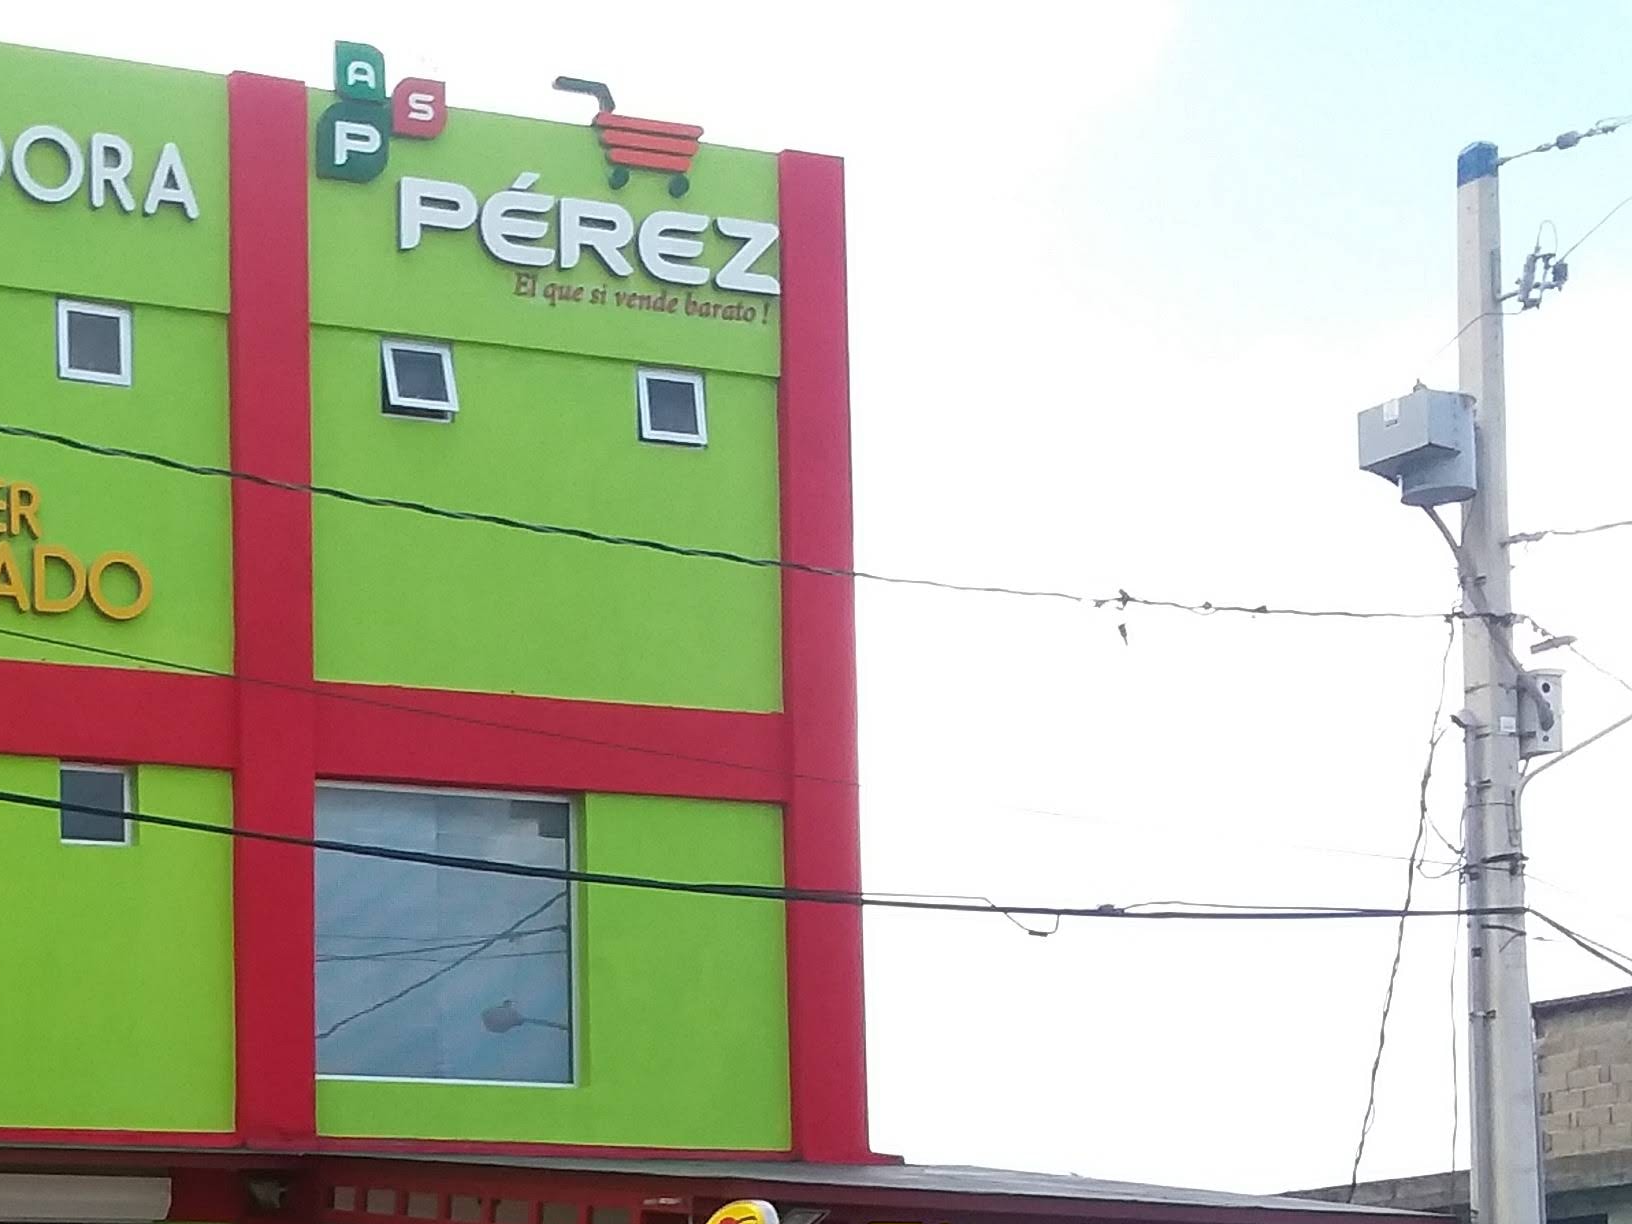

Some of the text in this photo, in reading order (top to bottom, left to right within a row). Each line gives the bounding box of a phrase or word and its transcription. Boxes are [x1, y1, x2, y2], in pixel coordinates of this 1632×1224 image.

[397, 171, 782, 295] PÉREZ
[513, 272, 537, 298] El
[543, 281, 583, 308] que
[615, 289, 679, 315] vende
